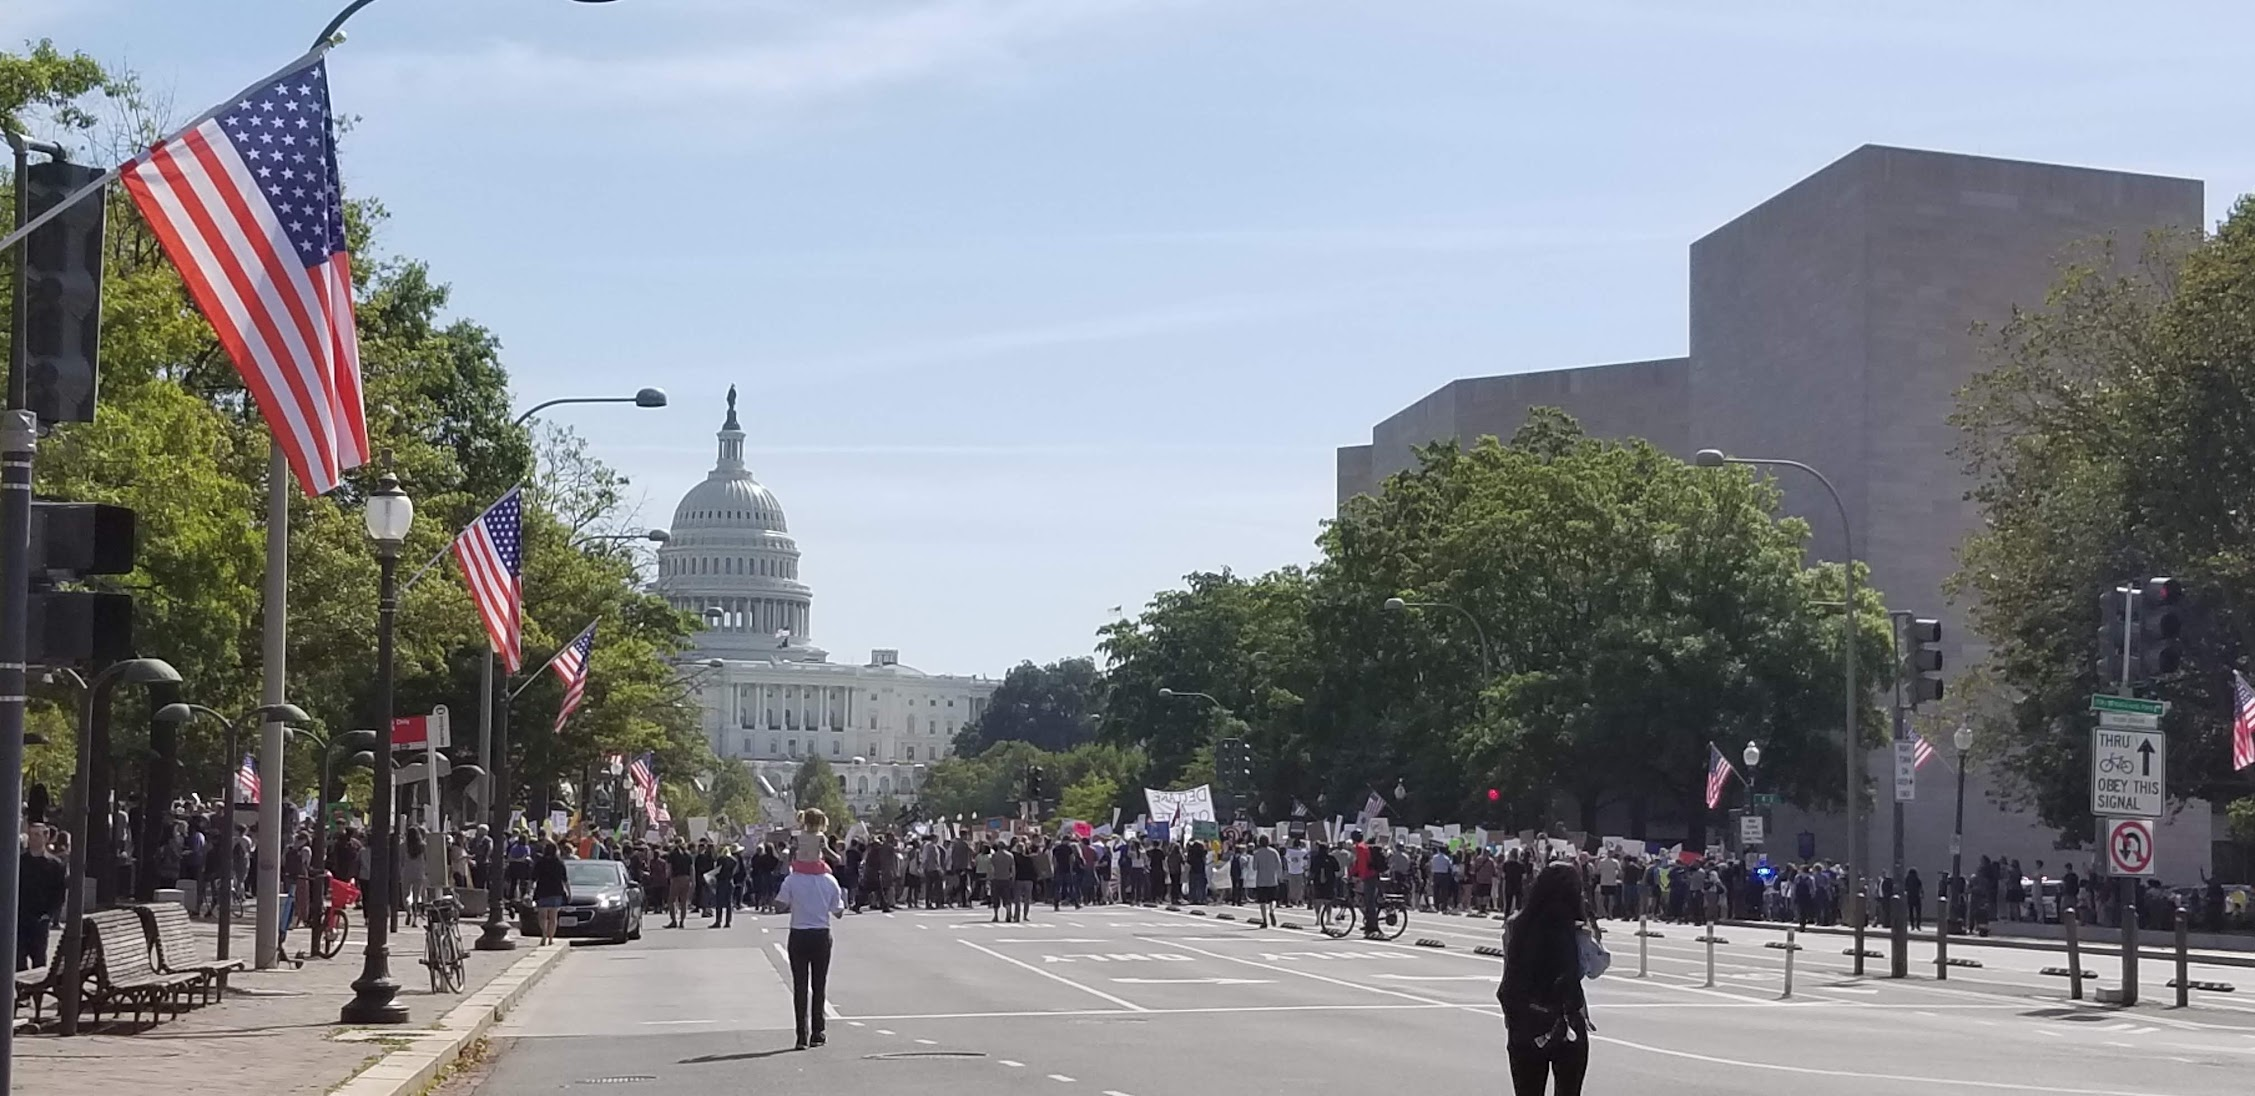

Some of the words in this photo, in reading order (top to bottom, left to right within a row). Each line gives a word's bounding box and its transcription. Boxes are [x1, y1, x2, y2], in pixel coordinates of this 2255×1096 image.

[2100, 733, 2130, 748] THRU
[2098, 778, 2128, 793] OBEY
[2133, 780, 2159, 795] THIS
[2097, 794, 2141, 810] SIGNAL
